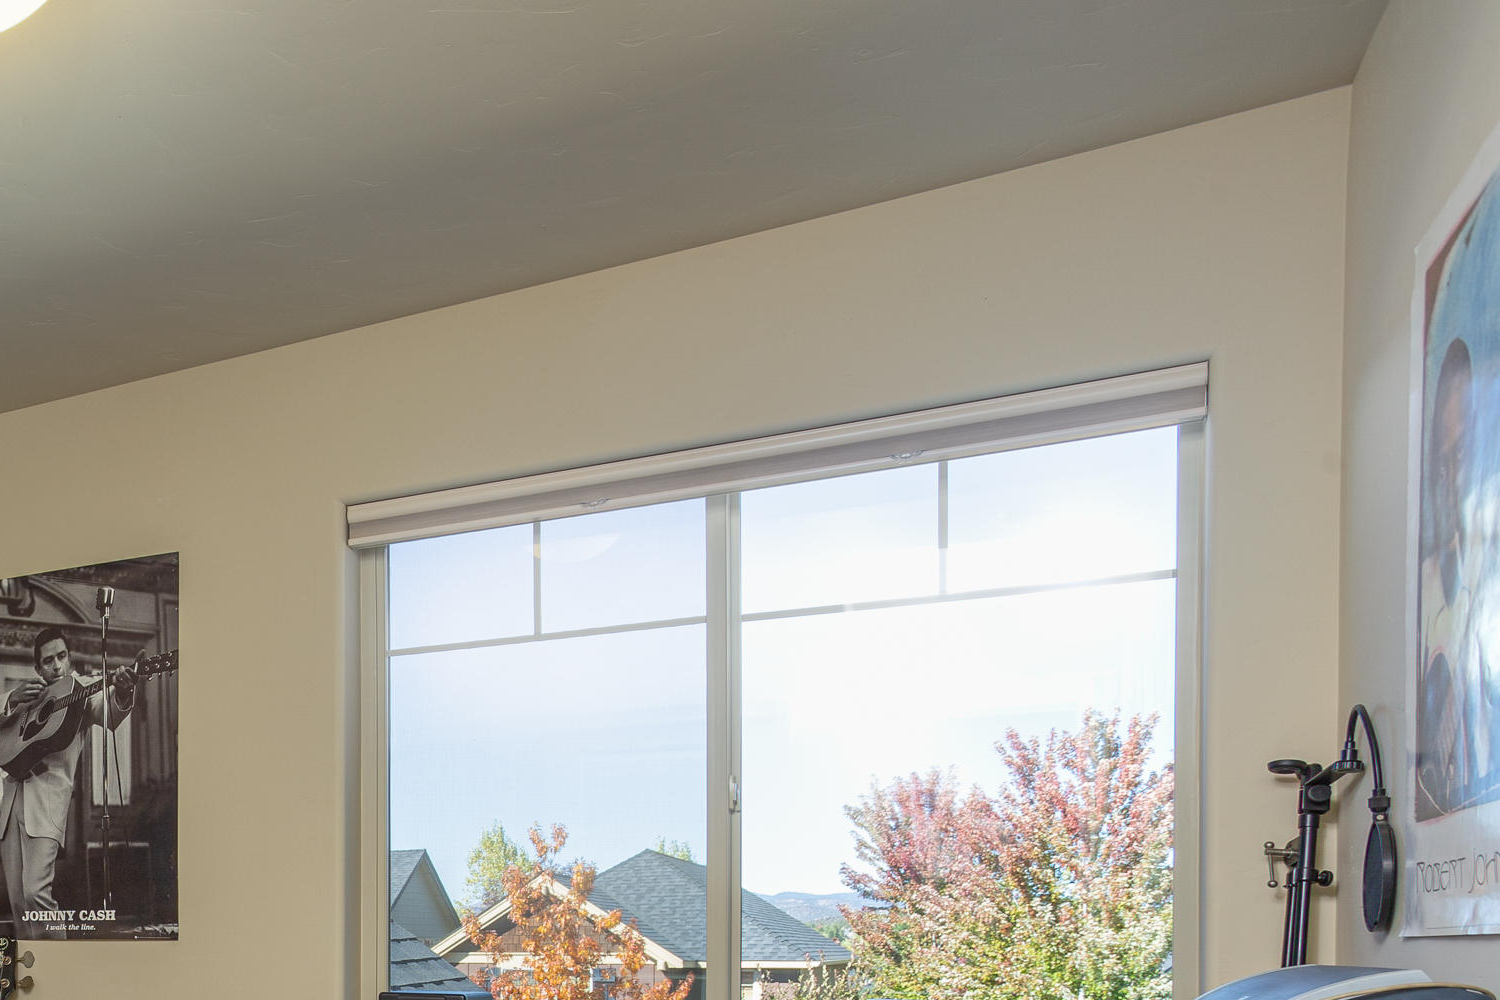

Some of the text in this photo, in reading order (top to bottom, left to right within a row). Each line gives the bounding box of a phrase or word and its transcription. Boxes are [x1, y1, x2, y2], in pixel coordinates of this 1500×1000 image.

[1416, 857, 1466, 894] ROBERT
[22, 909, 116, 922] JOHNNY CASH
[68, 923, 80, 931] the
[80, 923, 96, 931] line.
